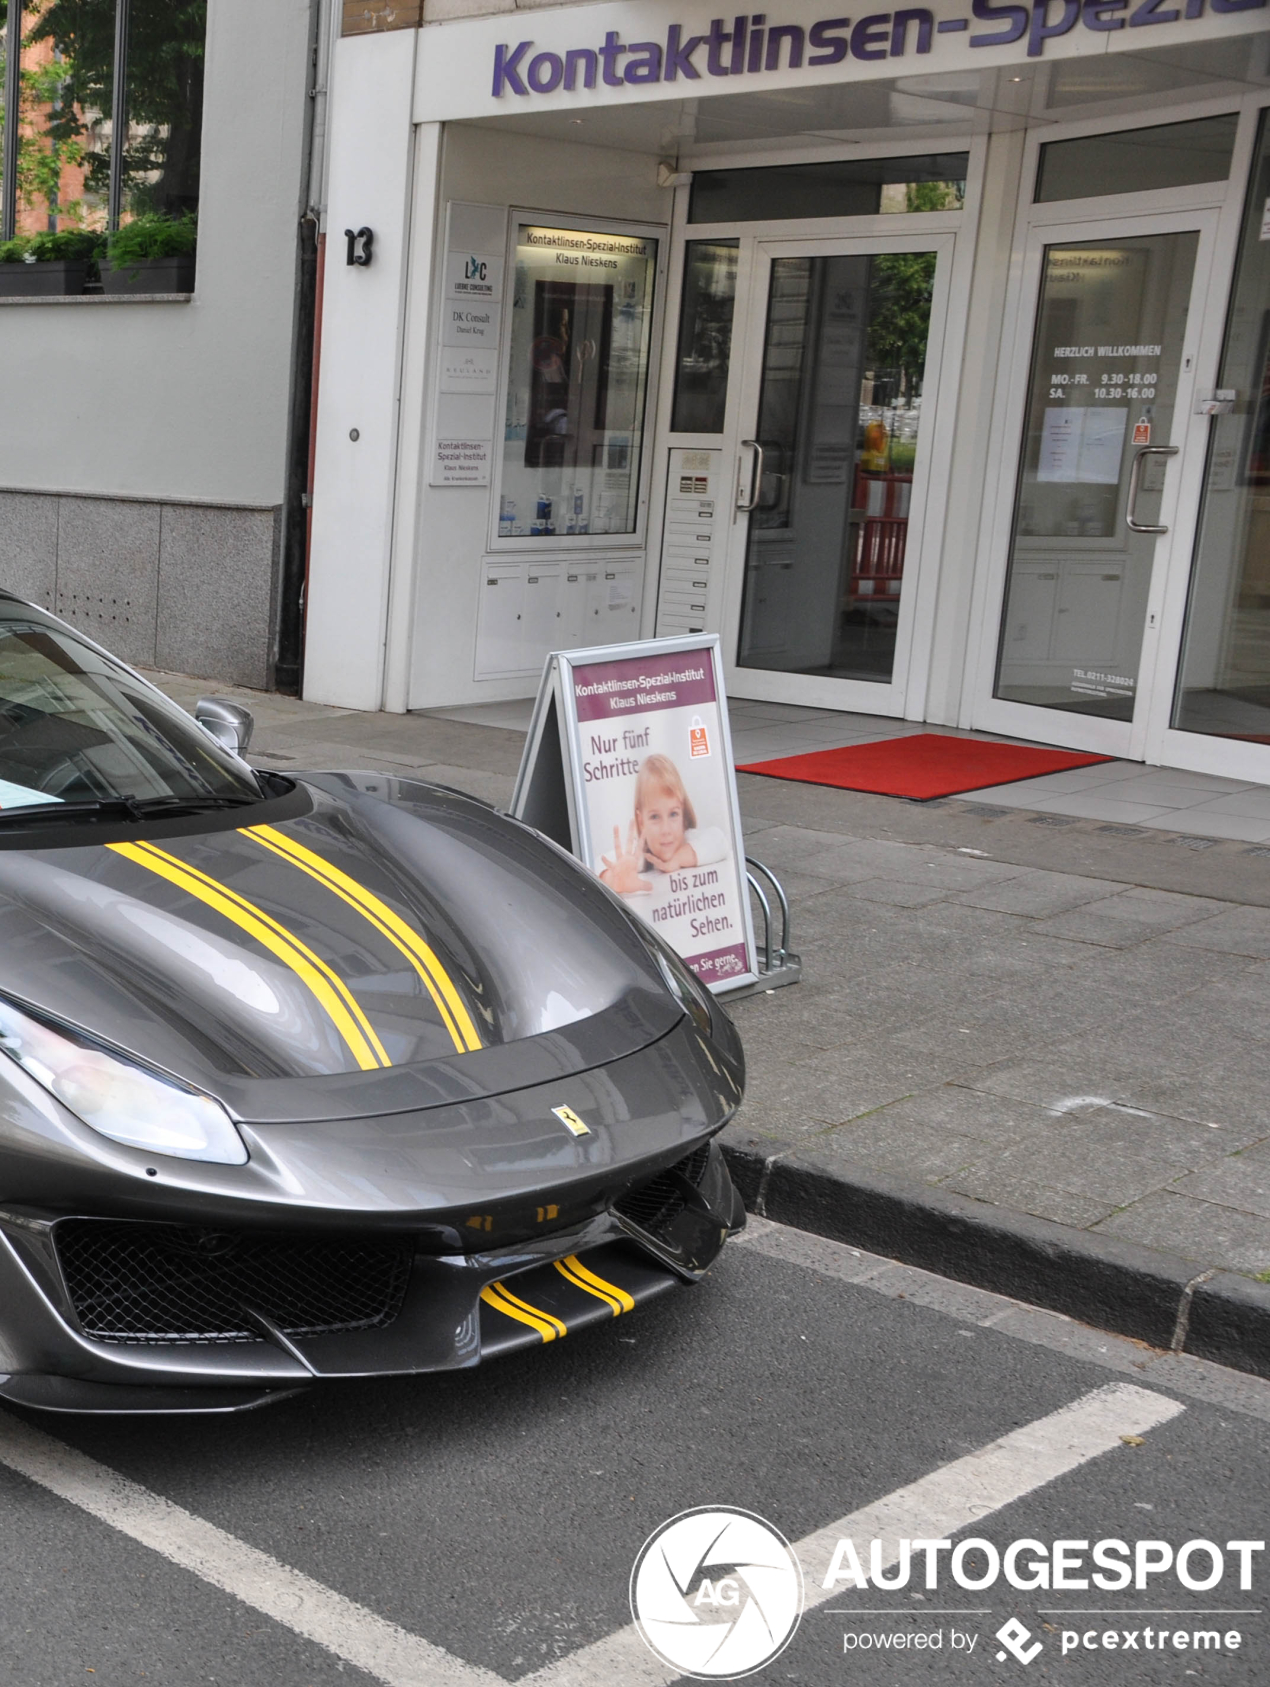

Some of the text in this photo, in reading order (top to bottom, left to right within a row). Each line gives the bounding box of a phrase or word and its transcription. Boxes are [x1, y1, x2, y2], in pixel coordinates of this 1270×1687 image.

[344, 226, 374, 266] 13
[527, 232, 647, 255] Kontaktlinsen-Spezial-Institut
[556, 253, 618, 269] Klaus Nieskens
[453, 312, 490, 323] DK Consult
[1054, 345, 1161, 357] HERZLICH WILLKOMMEN
[1051, 374, 1157, 384] MO.-FR. 9.30-18.00
[1049, 388, 1155, 398] SA. 10.30-16.00
[438, 442, 484, 450] Kontaktlinsen-
[437, 452, 487, 461] Spezial-Institut
[575, 668, 705, 697] Kontaktlinsen-Spezial-Institut
[610, 691, 677, 709] Klaus Nieskens
[591, 727, 650, 755] Nur fünf
[584, 758, 639, 782] Schritte
[669, 870, 718, 893] bis zum
[652, 892, 726, 923] natürlichen
[690, 916, 733, 938] Sehen.
[700, 957, 713, 971] Sie
[715, 953, 739, 970] gerne.
